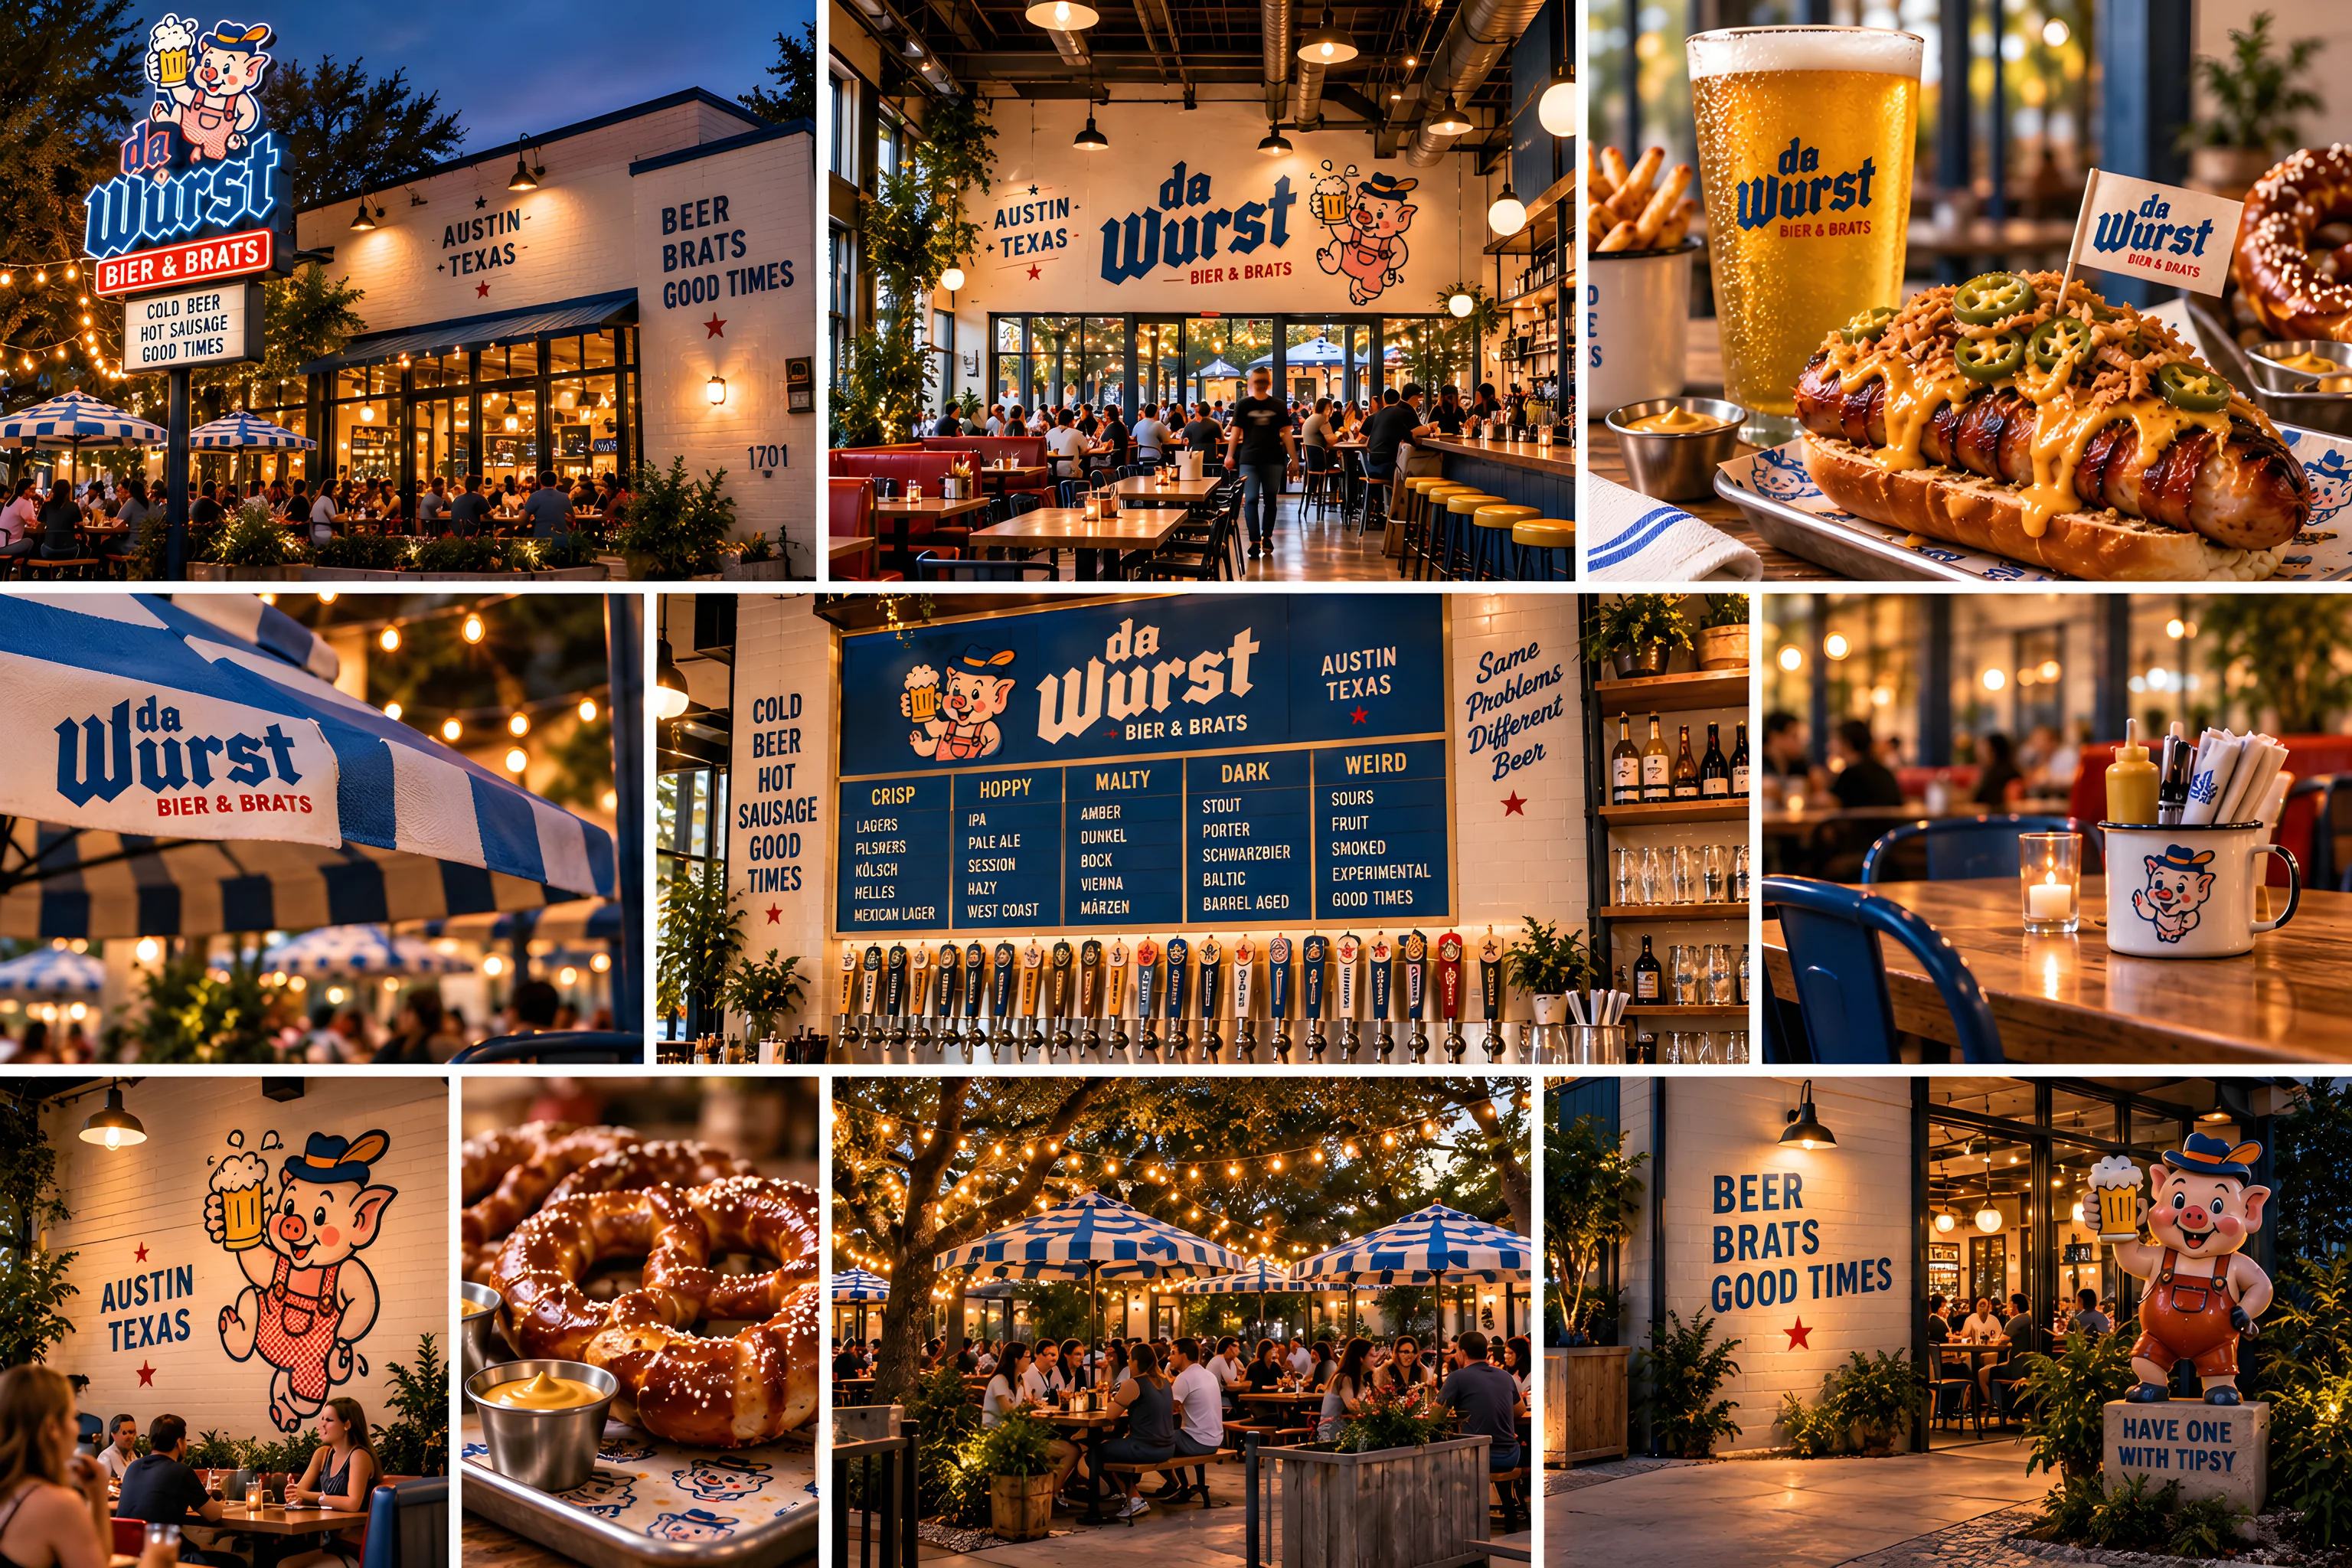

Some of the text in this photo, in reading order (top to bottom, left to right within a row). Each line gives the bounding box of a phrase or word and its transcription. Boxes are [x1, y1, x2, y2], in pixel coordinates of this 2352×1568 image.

[120, 119, 172, 176] da
[1779, 136, 1819, 176] da
[83, 132, 278, 260] Wurst
[1158, 159, 1211, 212] da
[1736, 156, 1876, 231] Wurst
[662, 195, 730, 236] BEER
[994, 197, 1070, 230] AUSTIN
[2139, 194, 2171, 219] da
[443, 207, 521, 250] AUSTIN
[1100, 174, 1298, 286] Wurst
[1780, 220, 1871, 237] BIER & BRATS
[2093, 209, 2214, 257] Wurst
[662, 229, 746, 273] BRATS
[1000, 228, 1067, 258] TEXAS
[105, 239, 260, 288] BIER & BRATS
[448, 242, 516, 278] TEXAS
[1191, 261, 1292, 285] BIER & BRATS
[663, 260, 795, 309] GOOD TIMES
[147, 294, 220, 320] COLD BEER
[141, 315, 228, 342] HOT SAUSAGE
[142, 338, 224, 362] GOOD TIMES
[746, 443, 789, 470] 1701
[1106, 617, 1161, 665] da
[1321, 645, 1397, 677] AUSTIN
[1476, 642, 1540, 684] Same
[1035, 626, 1260, 745] Wurst
[1326, 674, 1392, 701] TEXAS
[1465, 663, 1563, 723] Problems
[136, 694, 182, 733] da
[753, 693, 802, 725] COLD
[1125, 714, 1248, 741] BIER & BRATS
[1468, 693, 1563, 755] Different
[54, 697, 302, 808] Wurst
[753, 728, 801, 759] BEER
[1222, 761, 1270, 783] DARK
[1345, 752, 1407, 775] WEIRD
[1491, 743, 1547, 782] Beer
[758, 764, 796, 793] HOT
[980, 778, 1031, 799] HOPPY
[1096, 769, 1151, 791] MALTY
[157, 793, 312, 818] BIER & BRATS
[871, 786, 916, 806] CRISP
[1203, 798, 1241, 813] STOUT
[1331, 789, 1374, 806] SOURS
[738, 796, 818, 829] SAUSAGE
[856, 818, 898, 834] LAGERS
[969, 812, 986, 827] IPA
[1081, 805, 1121, 821] AMBER
[1332, 815, 1369, 831] FRUIT
[969, 833, 1021, 850] PALE ALE
[1081, 828, 1127, 844] DUNKEL
[1203, 822, 1250, 838] PORTER
[750, 833, 801, 862] GOOD
[1081, 852, 1112, 868] BOCK
[1203, 844, 1291, 863] SCHWARZBIER
[1332, 840, 1387, 857] SMOKED
[968, 858, 1016, 873] SESSION
[1203, 871, 1246, 887] BALTIC
[1332, 863, 1432, 881] EXPERIMENTAL
[747, 866, 802, 894] TIMES
[854, 885, 895, 900] HELLES
[968, 881, 997, 896] HAZY
[967, 903, 1039, 919] WEST COAST
[1203, 894, 1289, 911] BARREL AGED
[1332, 890, 1413, 906] GOOD TIMES
[902, 906, 936, 920] LAGER
[1713, 1172, 1804, 1215] BEER
[1713, 1218, 1819, 1264] BRATS
[100, 1264, 194, 1315] AUSTIN
[1712, 1256, 1893, 1314] GOOD TIMES
[108, 1308, 191, 1353] TEXAS
[2123, 1418, 2232, 1443] HAVE ONE
[2118, 1446, 2237, 1472] WITH TIPSY
